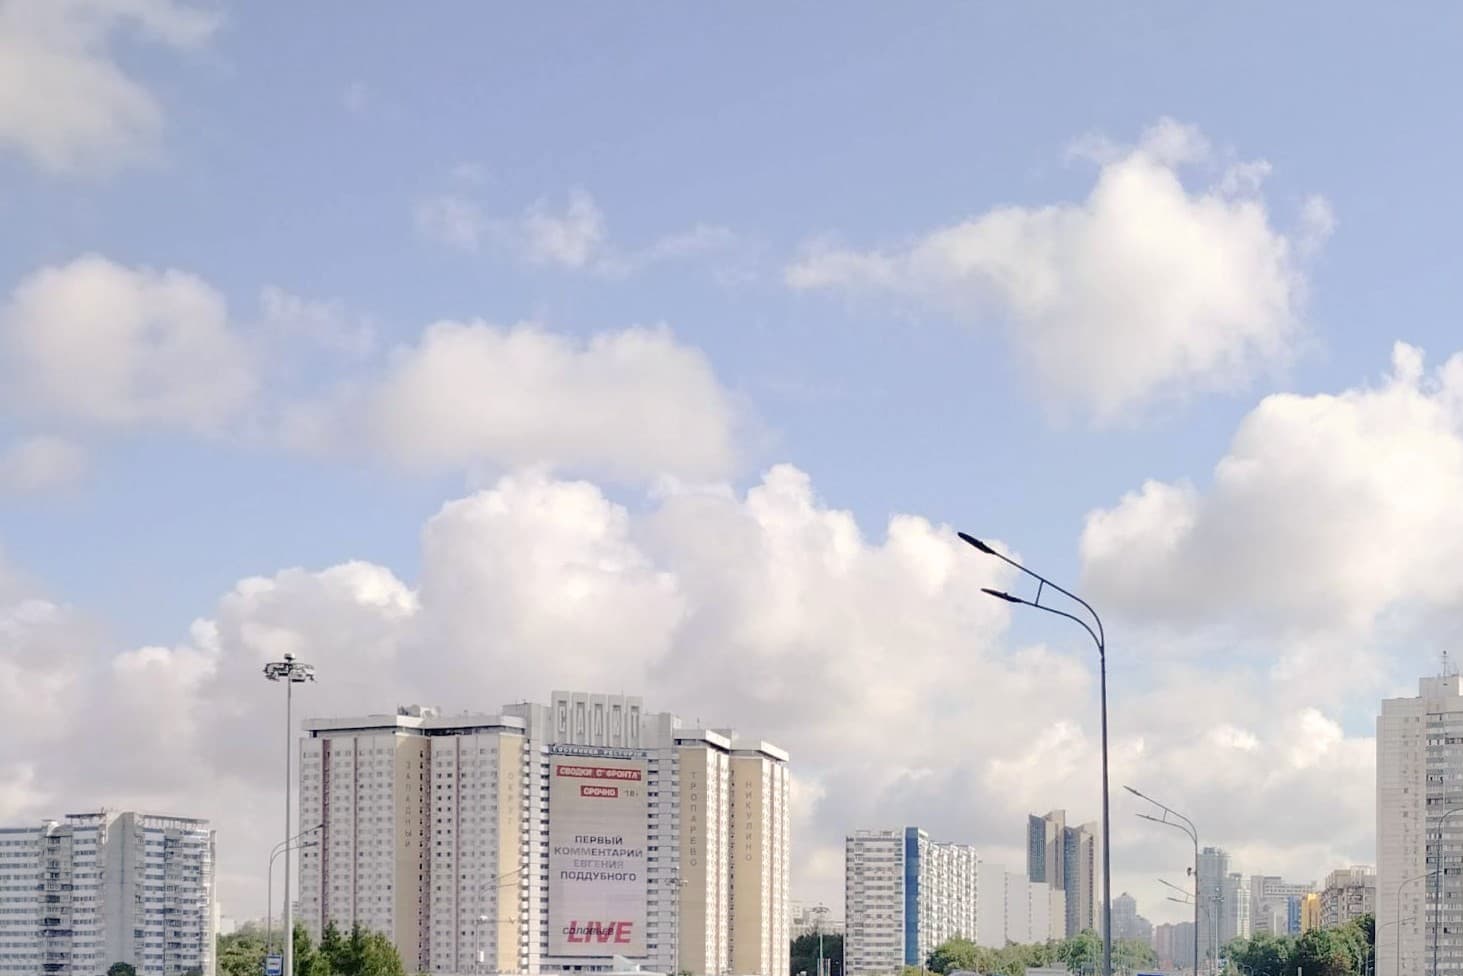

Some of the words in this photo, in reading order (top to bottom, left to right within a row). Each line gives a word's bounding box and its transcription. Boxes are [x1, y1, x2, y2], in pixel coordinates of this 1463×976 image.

[558, 702, 640, 738] САЛЮТ
[583, 787, 616, 796] СРОЧНО
[575, 834, 623, 845] ПЕРВЫЙ
[573, 858, 624, 869] ЕВГЕНИЯ
[560, 871, 637, 882] ПОДДУБНОГО
[567, 920, 633, 944] LIVE
